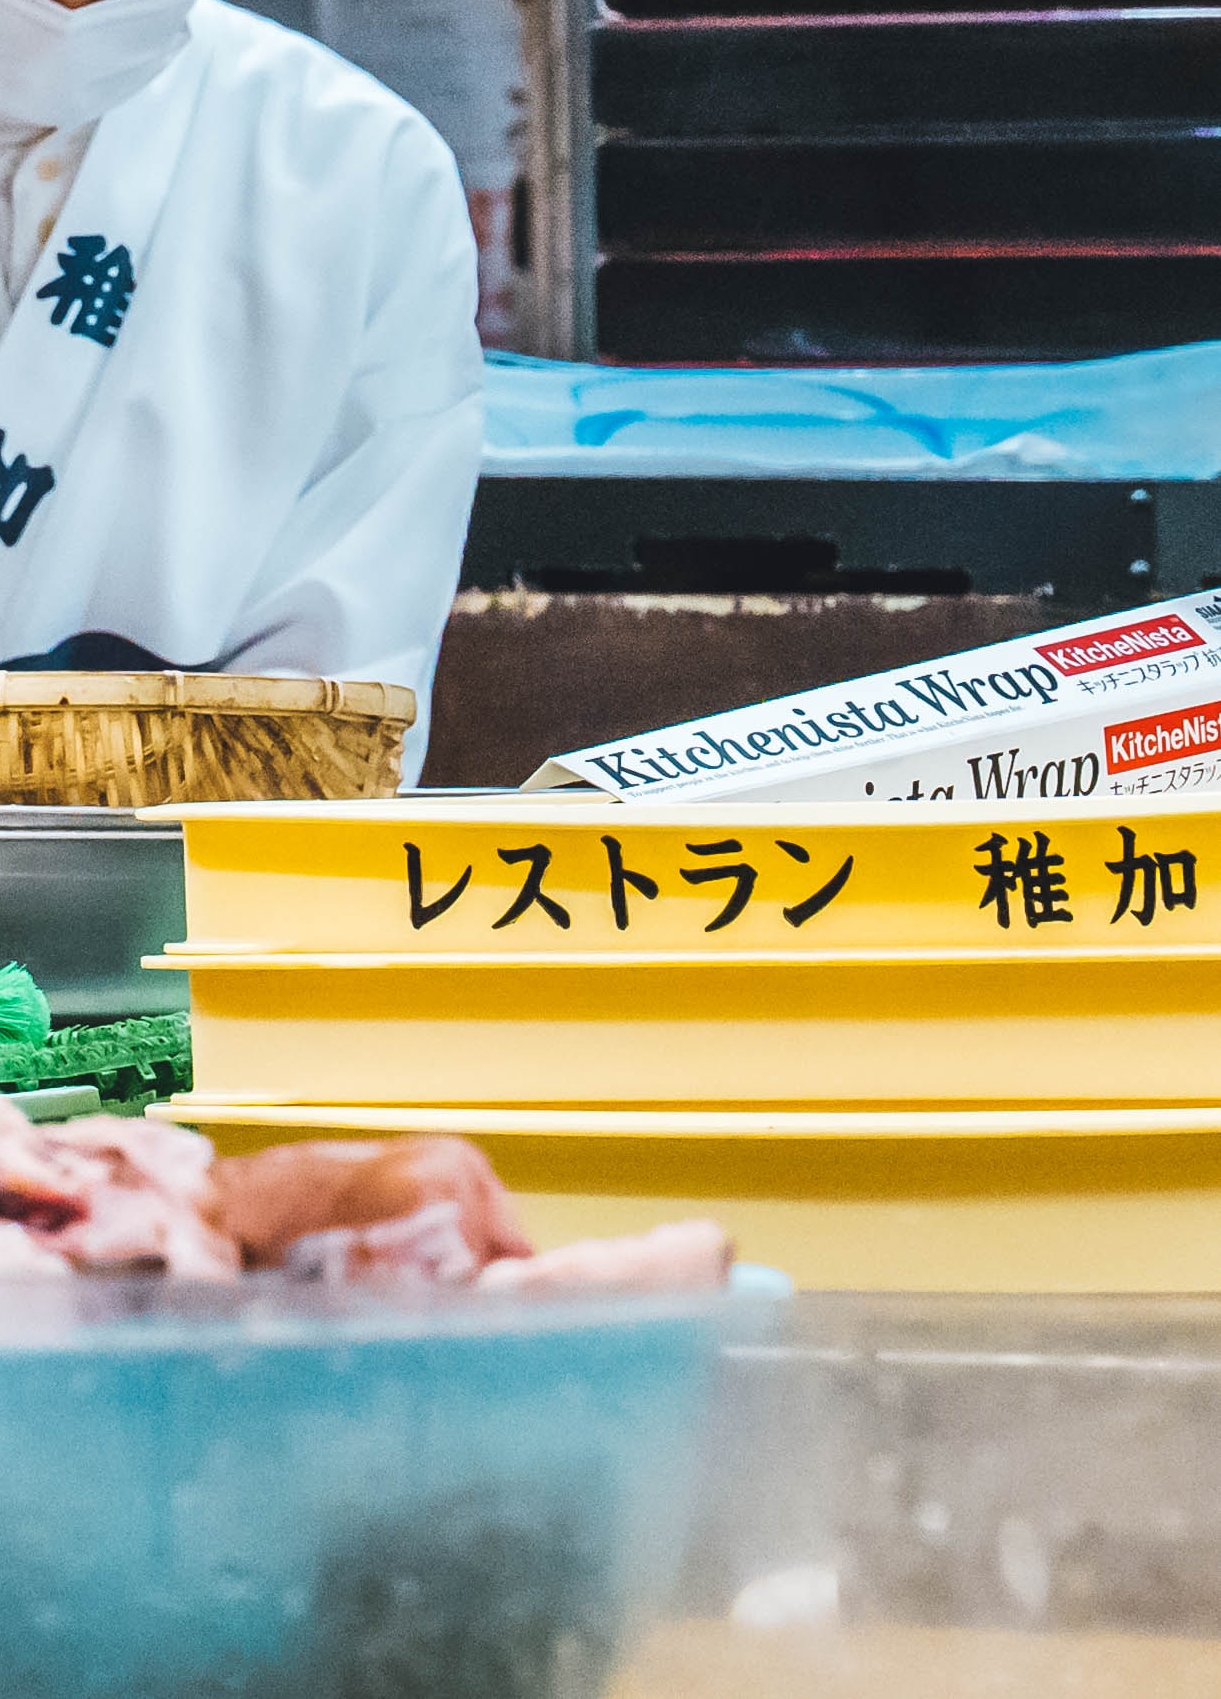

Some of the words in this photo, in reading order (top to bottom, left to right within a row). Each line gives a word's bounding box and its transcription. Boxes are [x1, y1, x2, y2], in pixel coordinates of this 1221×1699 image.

[1047, 625, 1194, 670] KitcheNista
[585, 700, 919, 790] Kitchenista
[895, 664, 1059, 705] Wrap
[967, 748, 1099, 799] Wrap
[404, 835, 854, 933] レストラン
